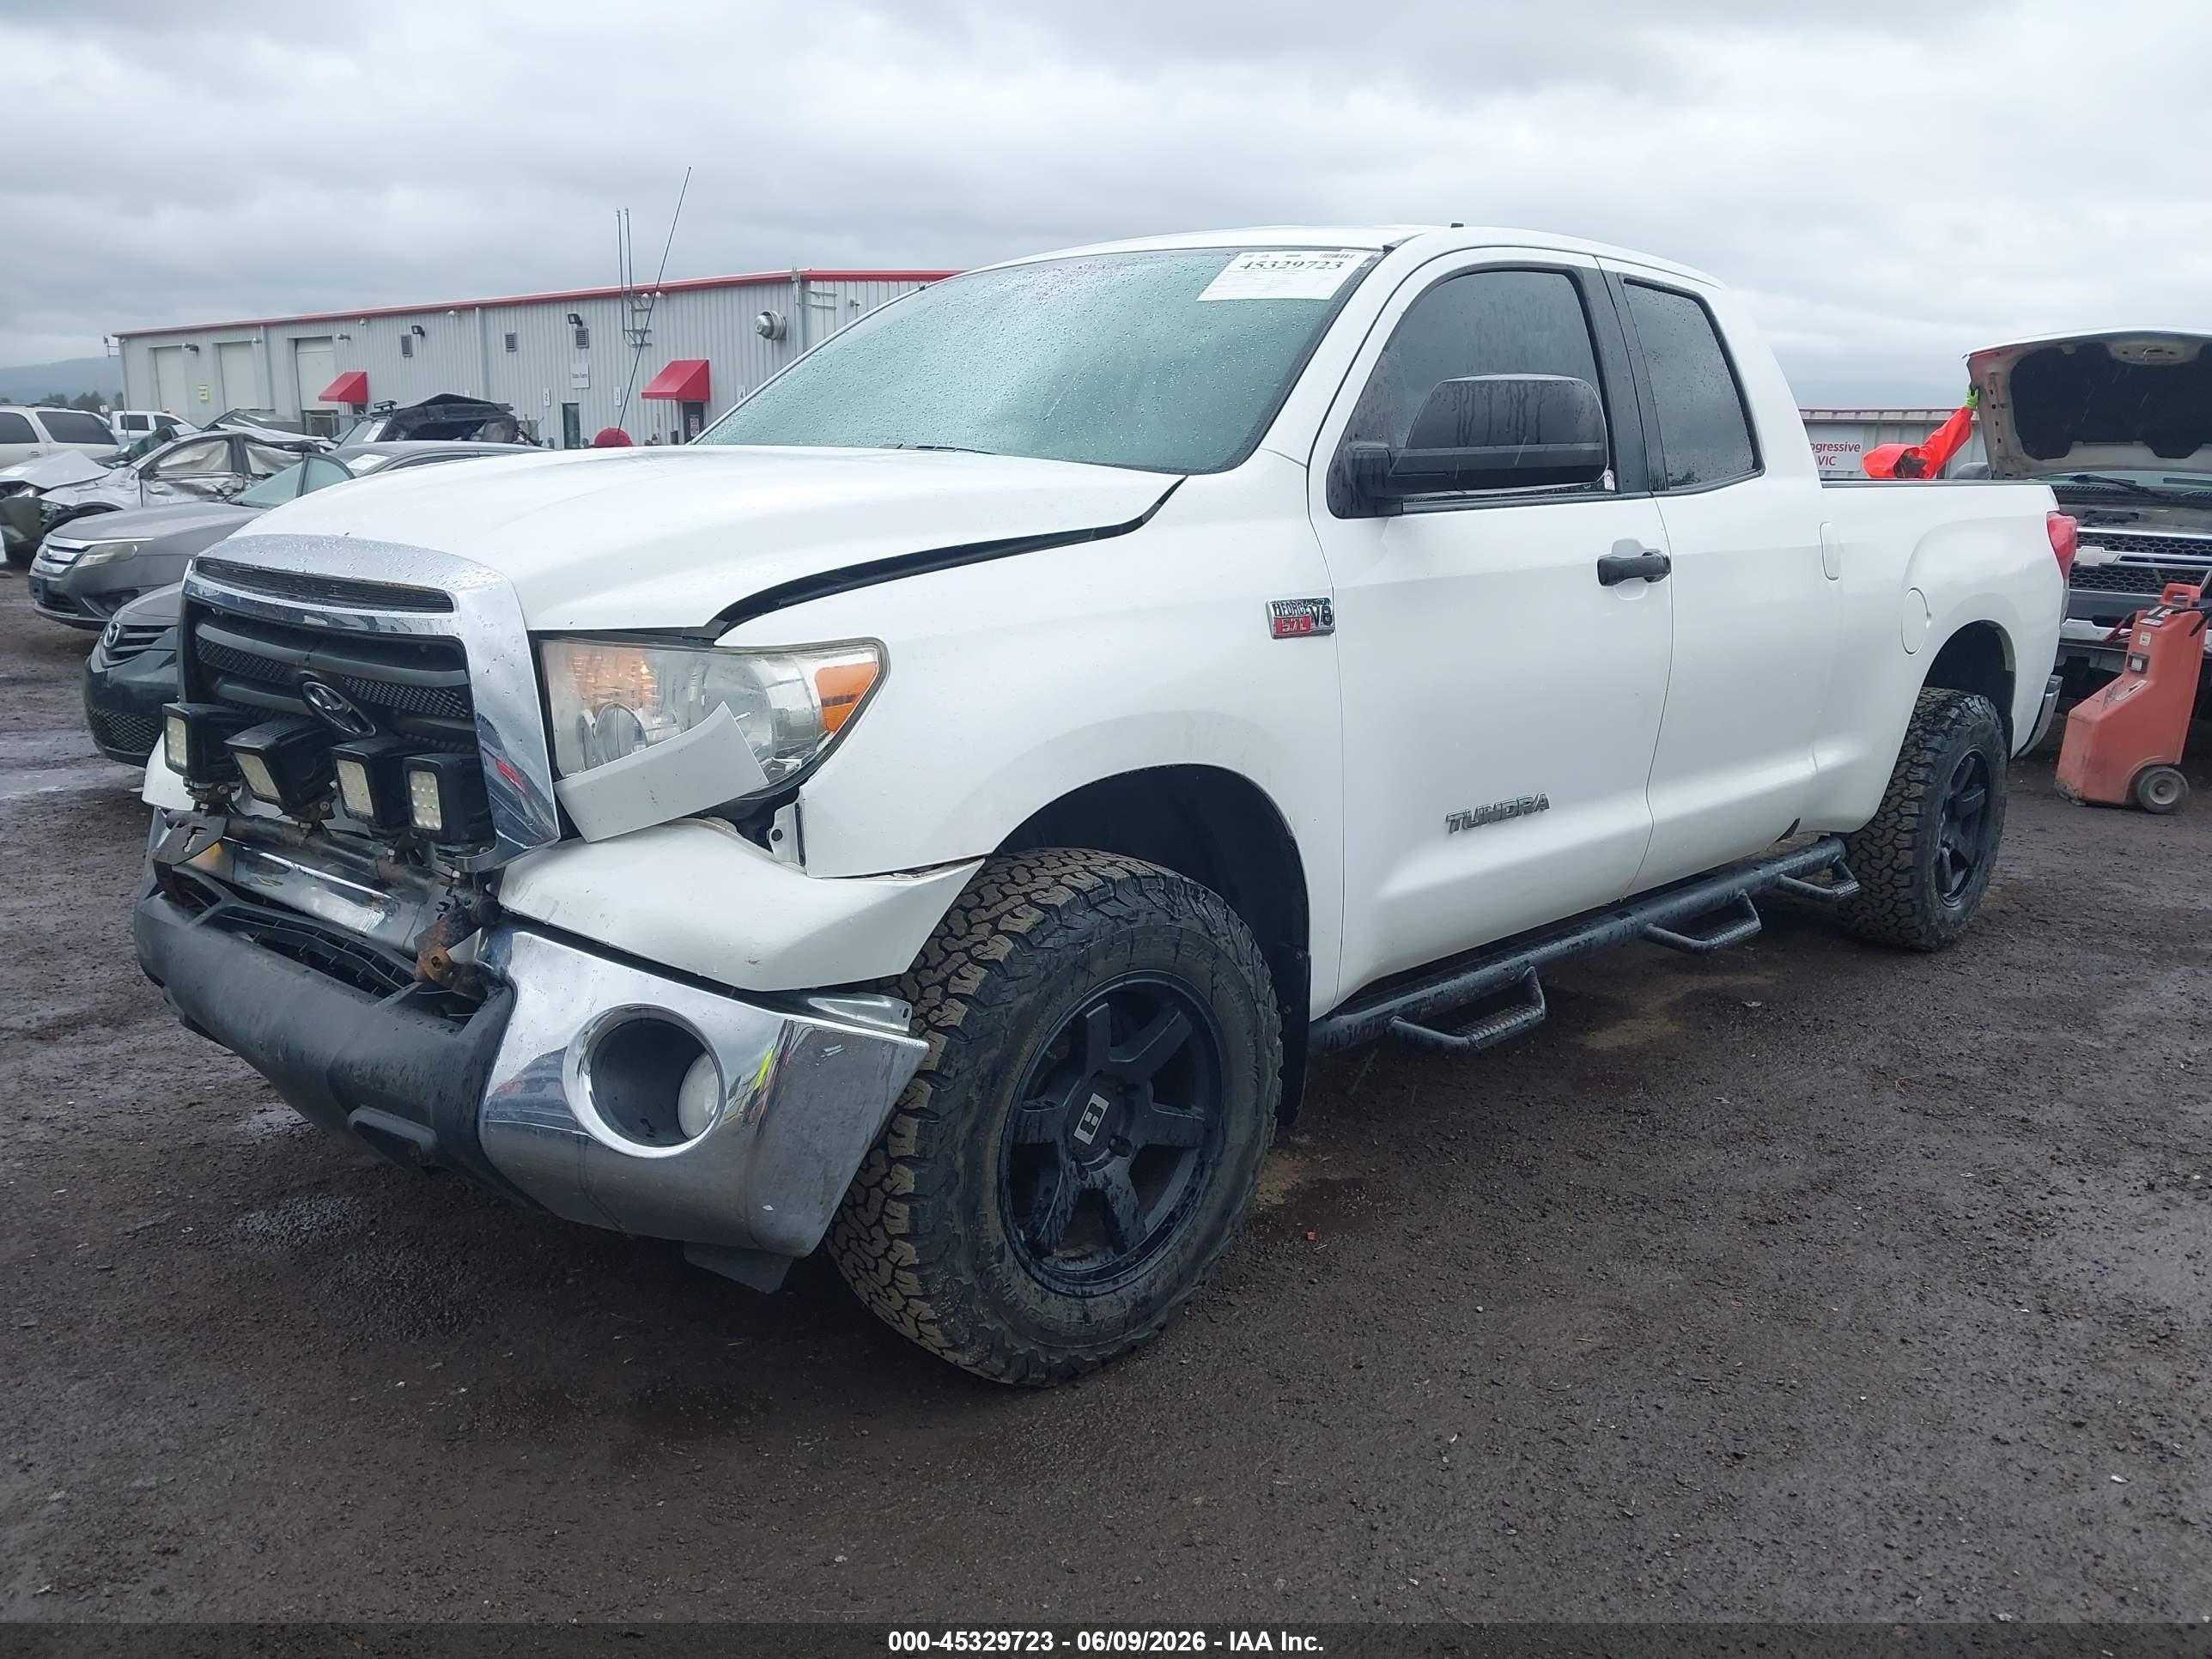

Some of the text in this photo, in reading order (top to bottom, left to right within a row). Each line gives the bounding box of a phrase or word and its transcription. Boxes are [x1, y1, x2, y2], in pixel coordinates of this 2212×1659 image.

[1239, 260, 1345, 270] 45329723
[1810, 441, 1862, 453] ogressive
[1818, 455, 1838, 466] VIC
[1309, 605, 1333, 627] V8
[1445, 791, 1552, 834] TUNDRA
